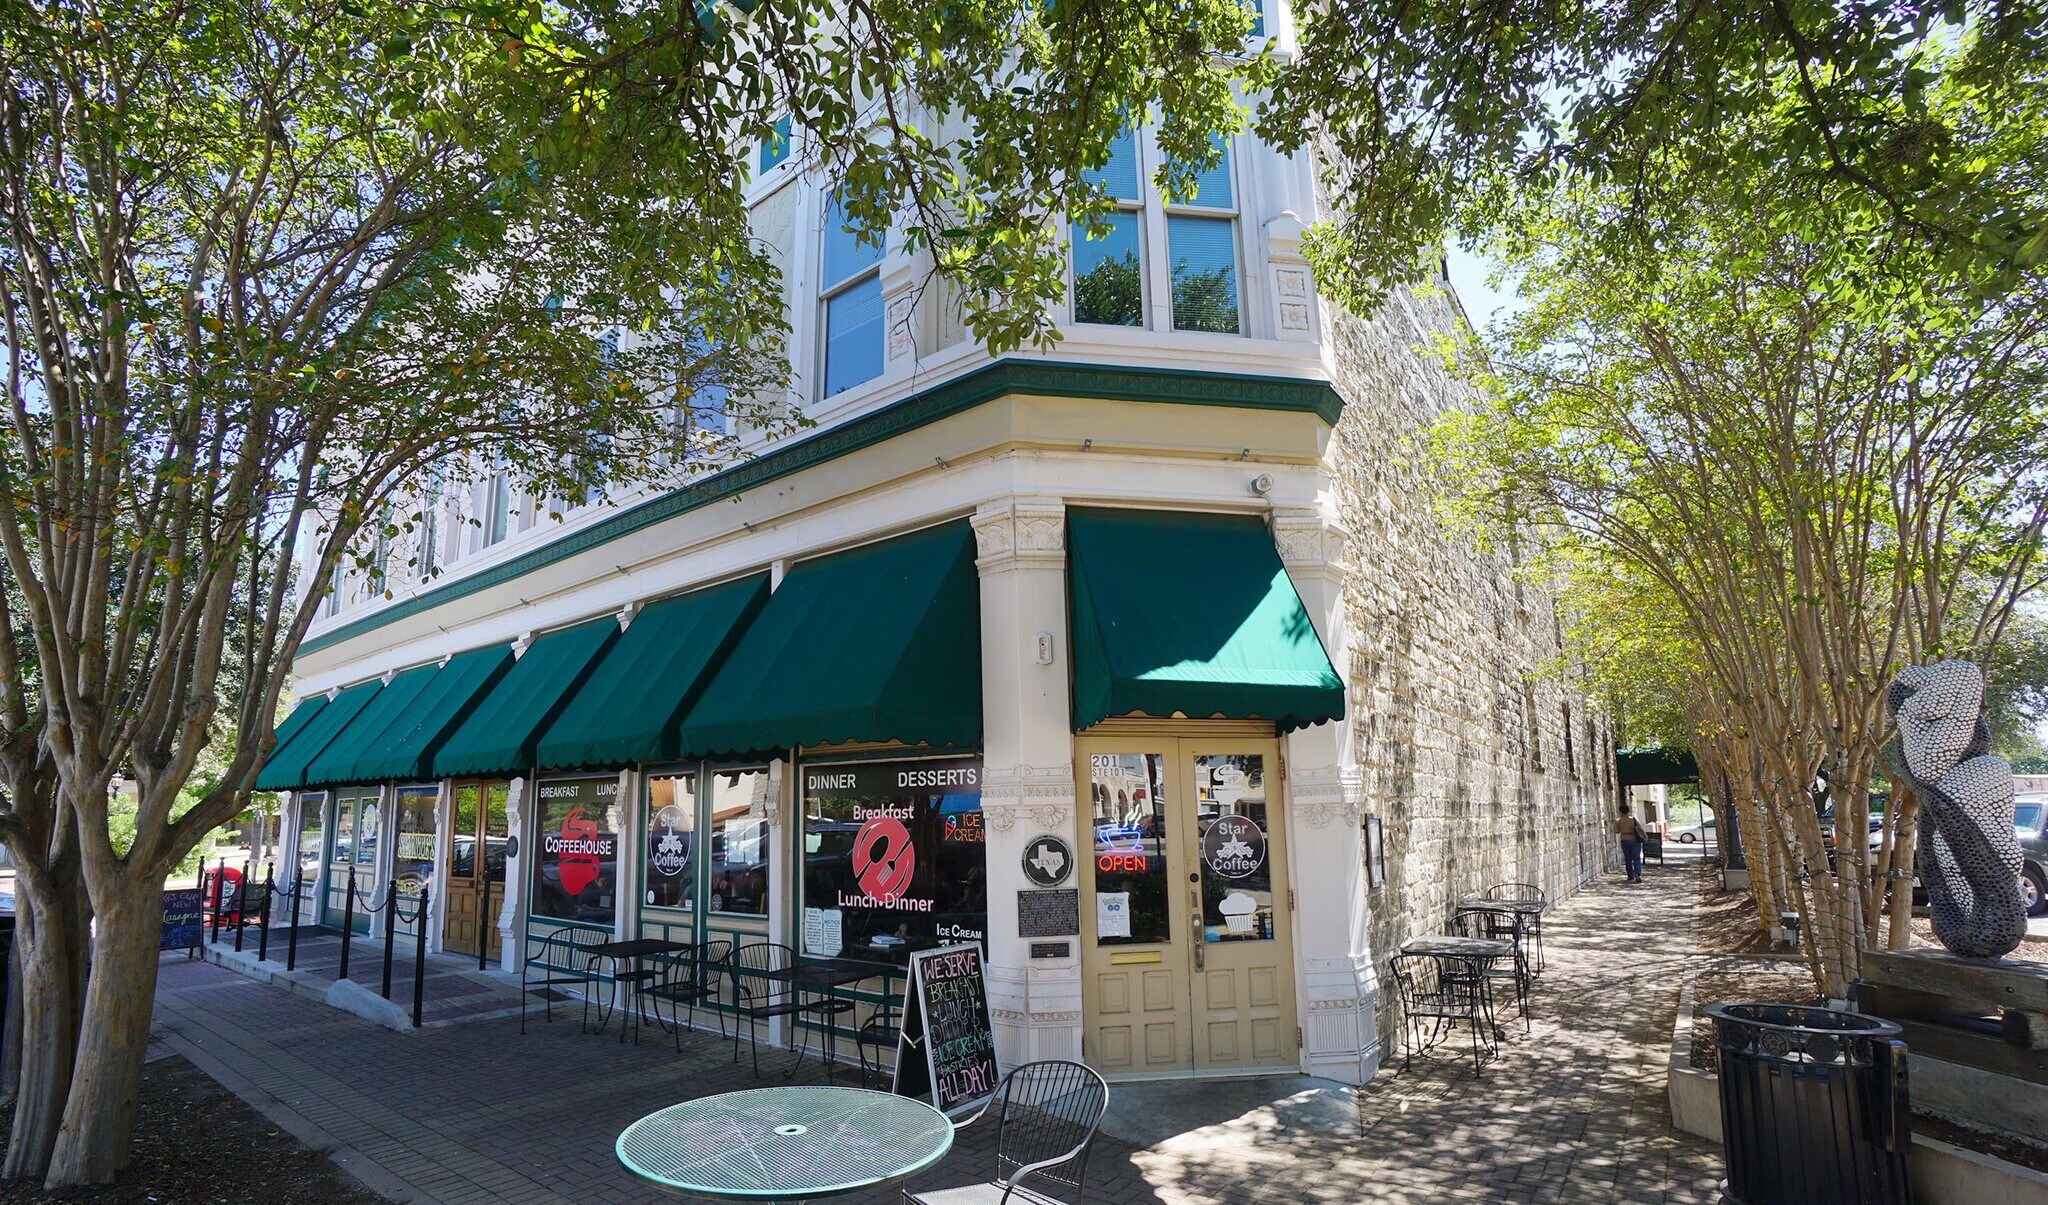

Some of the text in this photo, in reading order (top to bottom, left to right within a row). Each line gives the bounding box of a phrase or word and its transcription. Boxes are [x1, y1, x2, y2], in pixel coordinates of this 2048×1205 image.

[1092, 755, 1118, 768] 201
[808, 768, 977, 790] DINNER DESSERTS
[540, 783, 618, 798] BREAKFAST LUNC
[853, 803, 915, 820] Breakfast
[660, 814, 680, 828] Star
[962, 813, 981, 827] ICE
[1219, 822, 1248, 835] Star
[545, 836, 612, 855] COFFEEHOUSE
[654, 853, 685, 867] Coffee
[1099, 855, 1146, 872] OPEN
[1212, 857, 1258, 871] Coffee
[1107, 904, 1121, 912] GO
[936, 923, 982, 939] ICE CREAM
[923, 953, 978, 980] WE SERVE
[926, 975, 980, 1003] BREAKFAST
[937, 1040, 955, 1063] ICE
[938, 1072, 962, 1106] ALL
